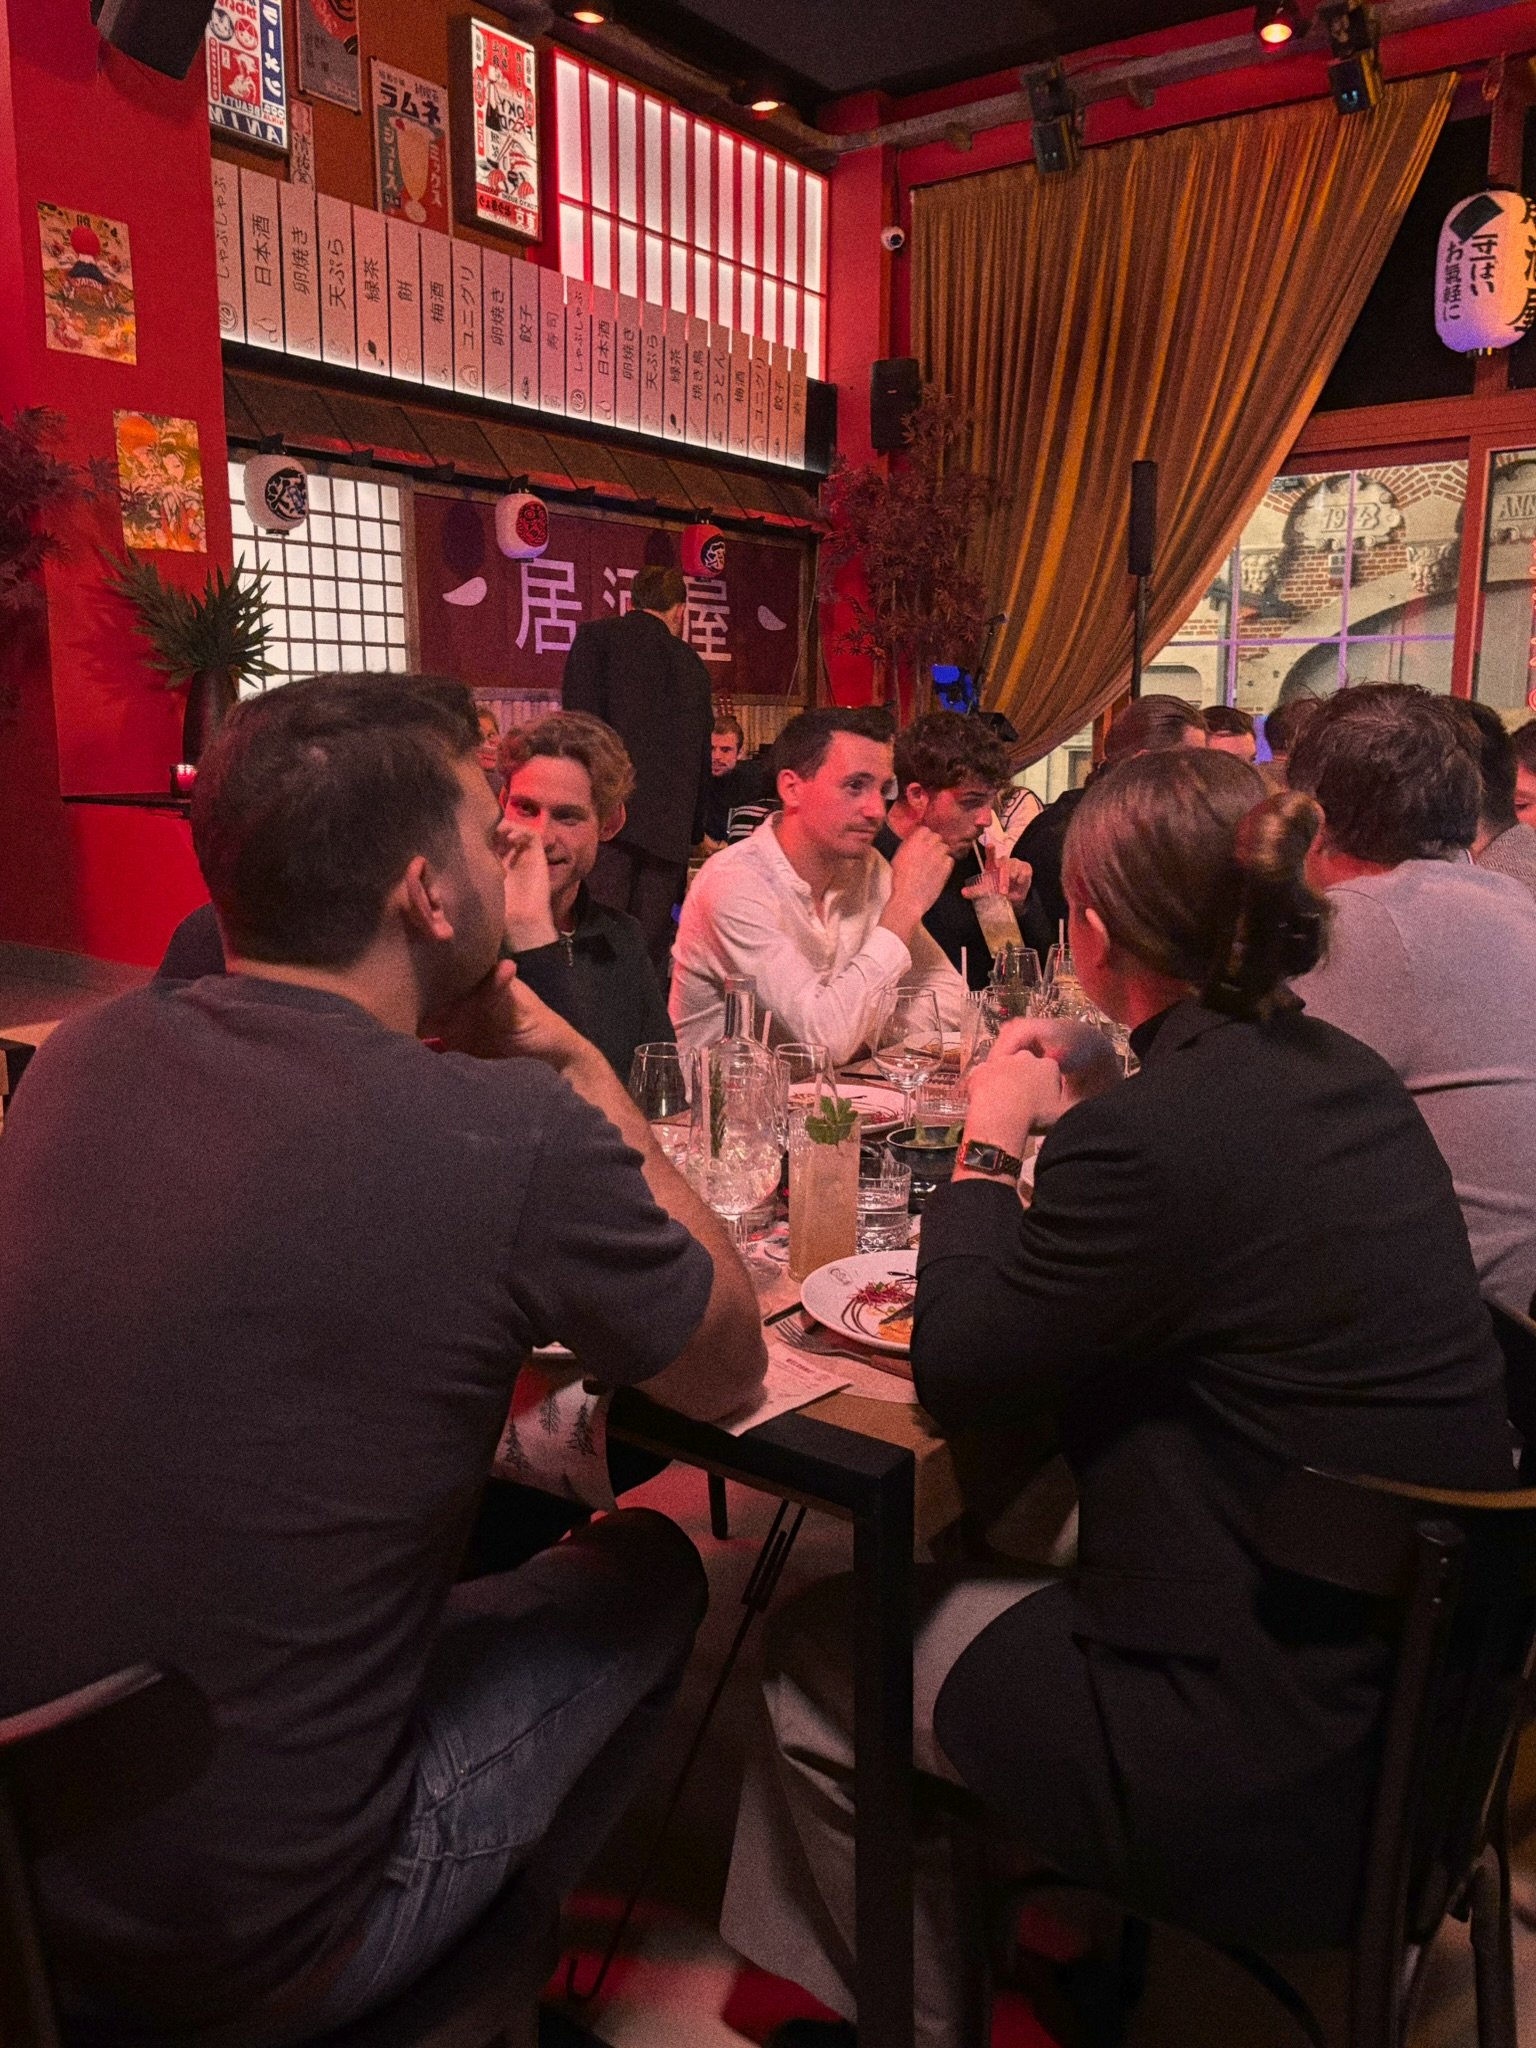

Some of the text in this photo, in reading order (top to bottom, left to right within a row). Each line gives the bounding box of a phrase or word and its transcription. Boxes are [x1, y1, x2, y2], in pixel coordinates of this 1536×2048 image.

[380, 82, 441, 126] ラムネ
[252, 215, 272, 287] 日本酒
[292, 226, 311, 295] 卵焼き
[328, 239, 347, 310] 天ぷら
[364, 257, 381, 303] 緑茶
[429, 282, 445, 324] 梅酒
[489, 287, 506, 347] 卵焼き
[519, 304, 534, 343] 餃子
[598, 320, 611, 376] 日本酒
[622, 328, 635, 380] 卵焼き
[671, 349, 685, 385] 緑茶
